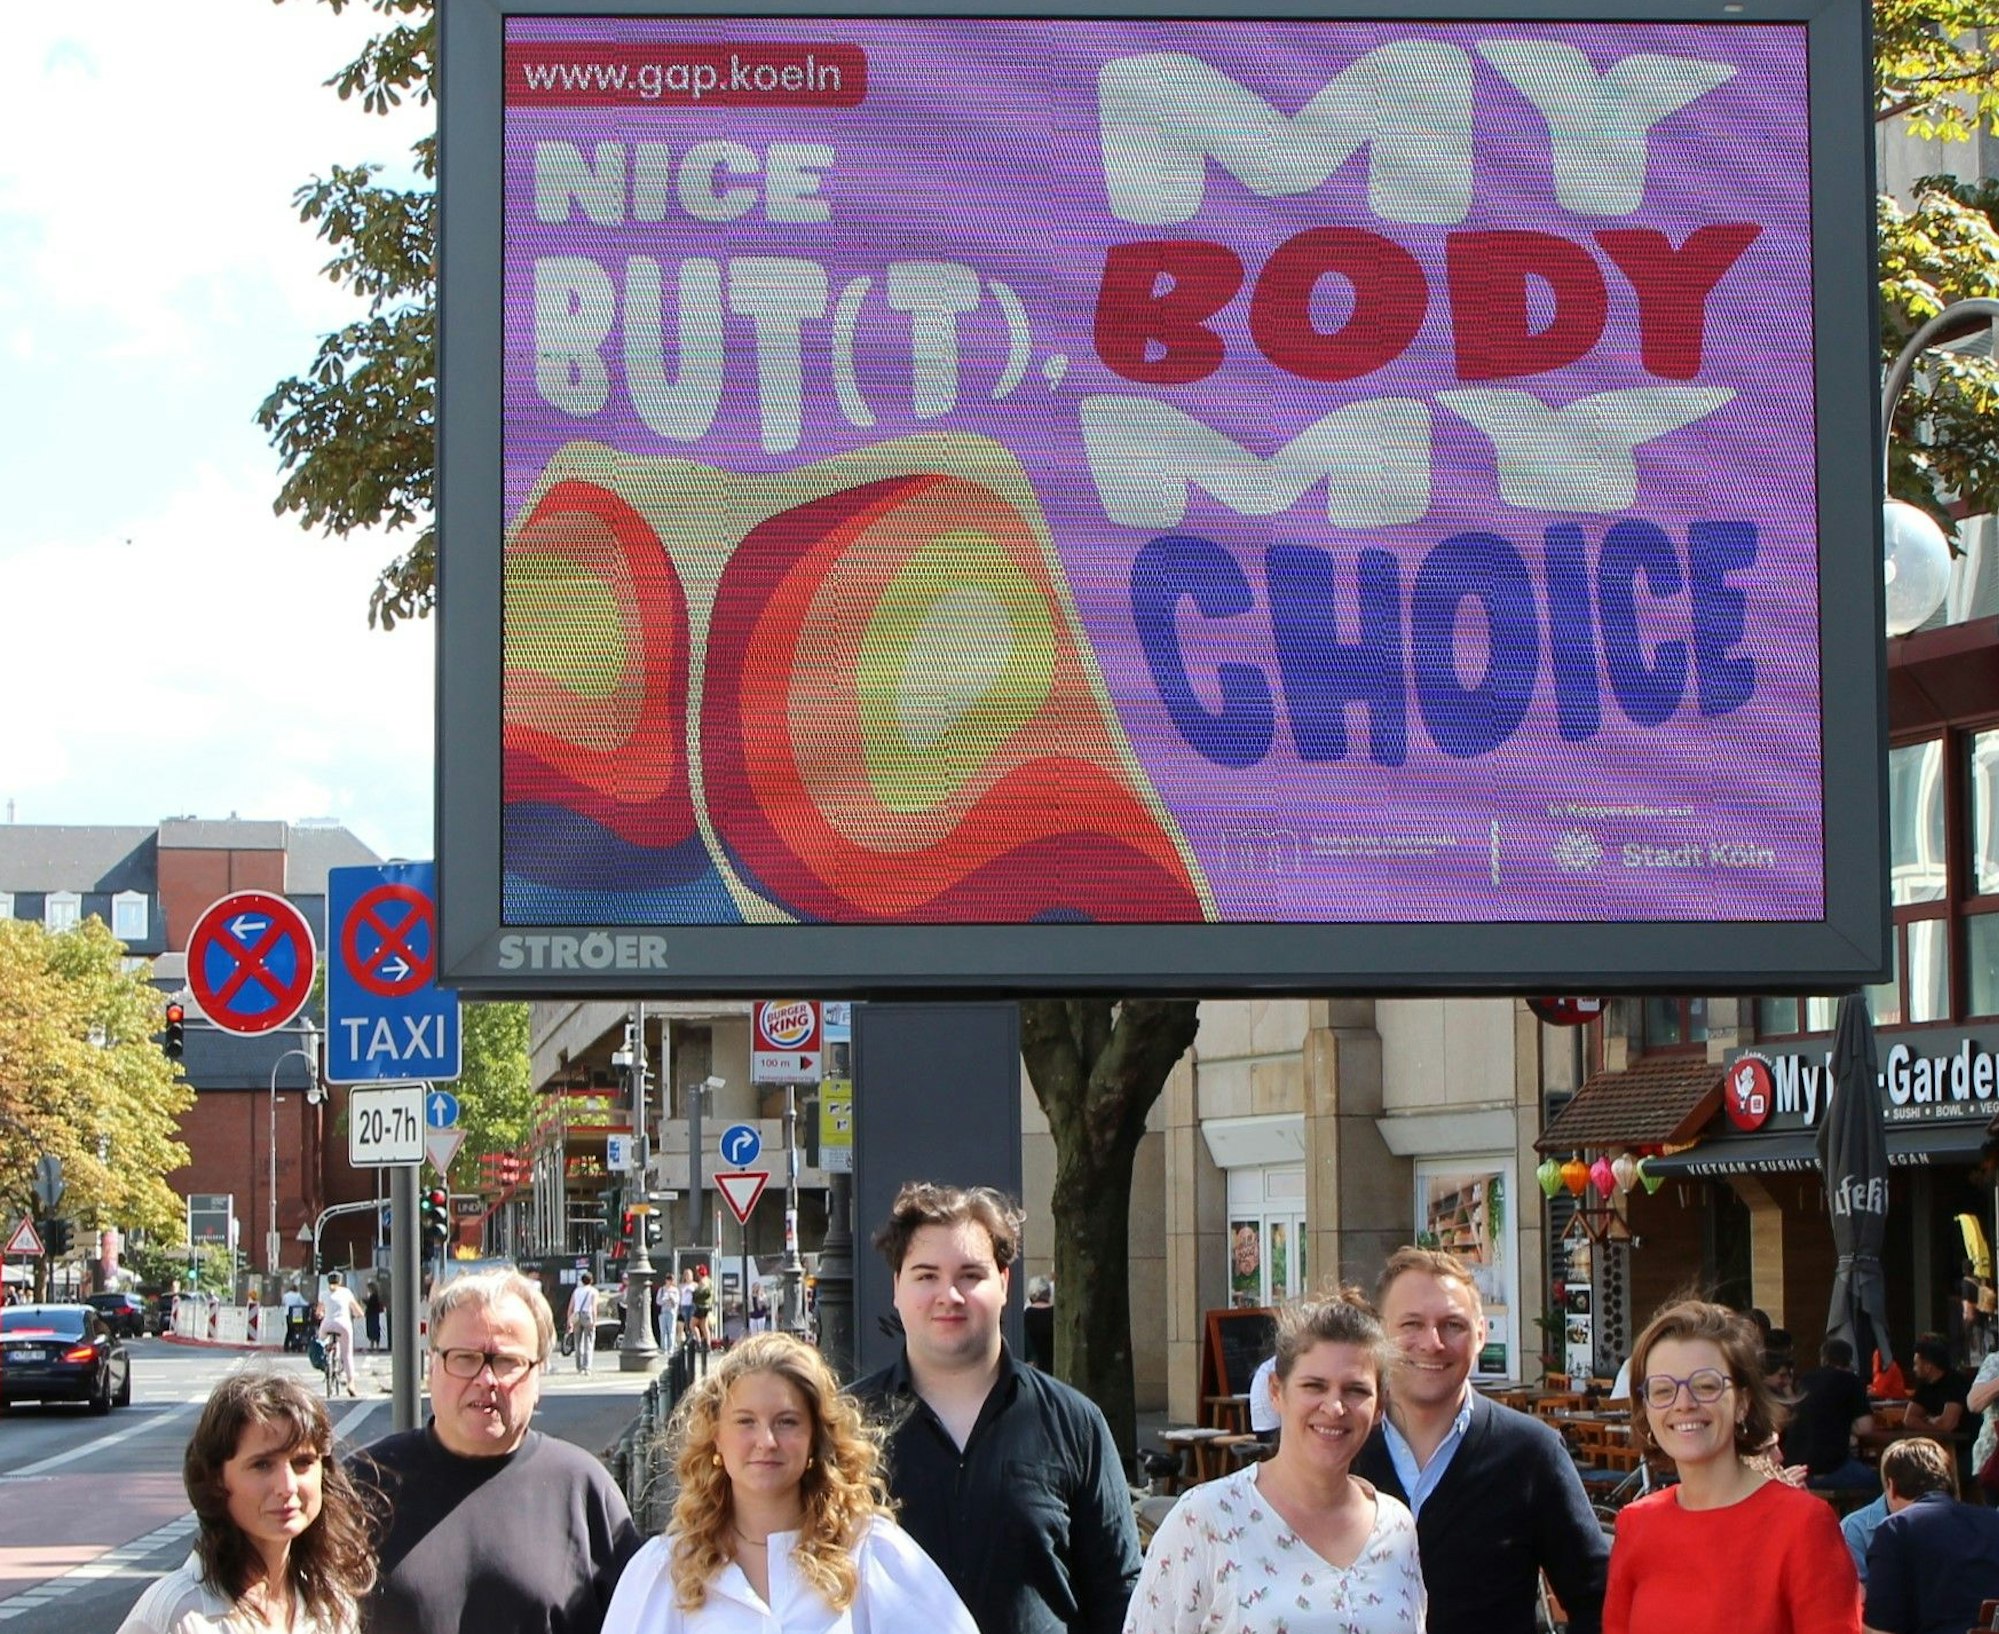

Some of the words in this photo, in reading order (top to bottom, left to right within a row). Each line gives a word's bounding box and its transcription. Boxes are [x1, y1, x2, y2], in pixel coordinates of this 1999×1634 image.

[523, 54, 842, 99] www.gap.koeln
[1099, 39, 1738, 225] MY
[533, 138, 836, 227] NICE
[1094, 223, 1763, 383] BODY
[534, 255, 1068, 455] BUT(T),
[1080, 386, 1738, 529] MY
[1130, 518, 1760, 768] CHOICE
[1622, 842, 1704, 867] Stadt
[1708, 841, 1776, 867] Köln
[498, 932, 668, 970] STRÖER
[767, 1004, 807, 1023] BURGER
[768, 1014, 809, 1036] KING
[340, 1014, 445, 1062] TAXI
[761, 1059, 778, 1068] 100
[780, 1060, 790, 1068] m
[1775, 1054, 1819, 1125] My
[1893, 1107, 1921, 1120] SUSHI
[1935, 1104, 1964, 1118] BOWL
[358, 1106, 417, 1145] 20-7h
[1686, 1161, 1748, 1175] VIETNAM
[1759, 1159, 1803, 1172] SUSHI
[1887, 1153, 1931, 1166] EGAN
